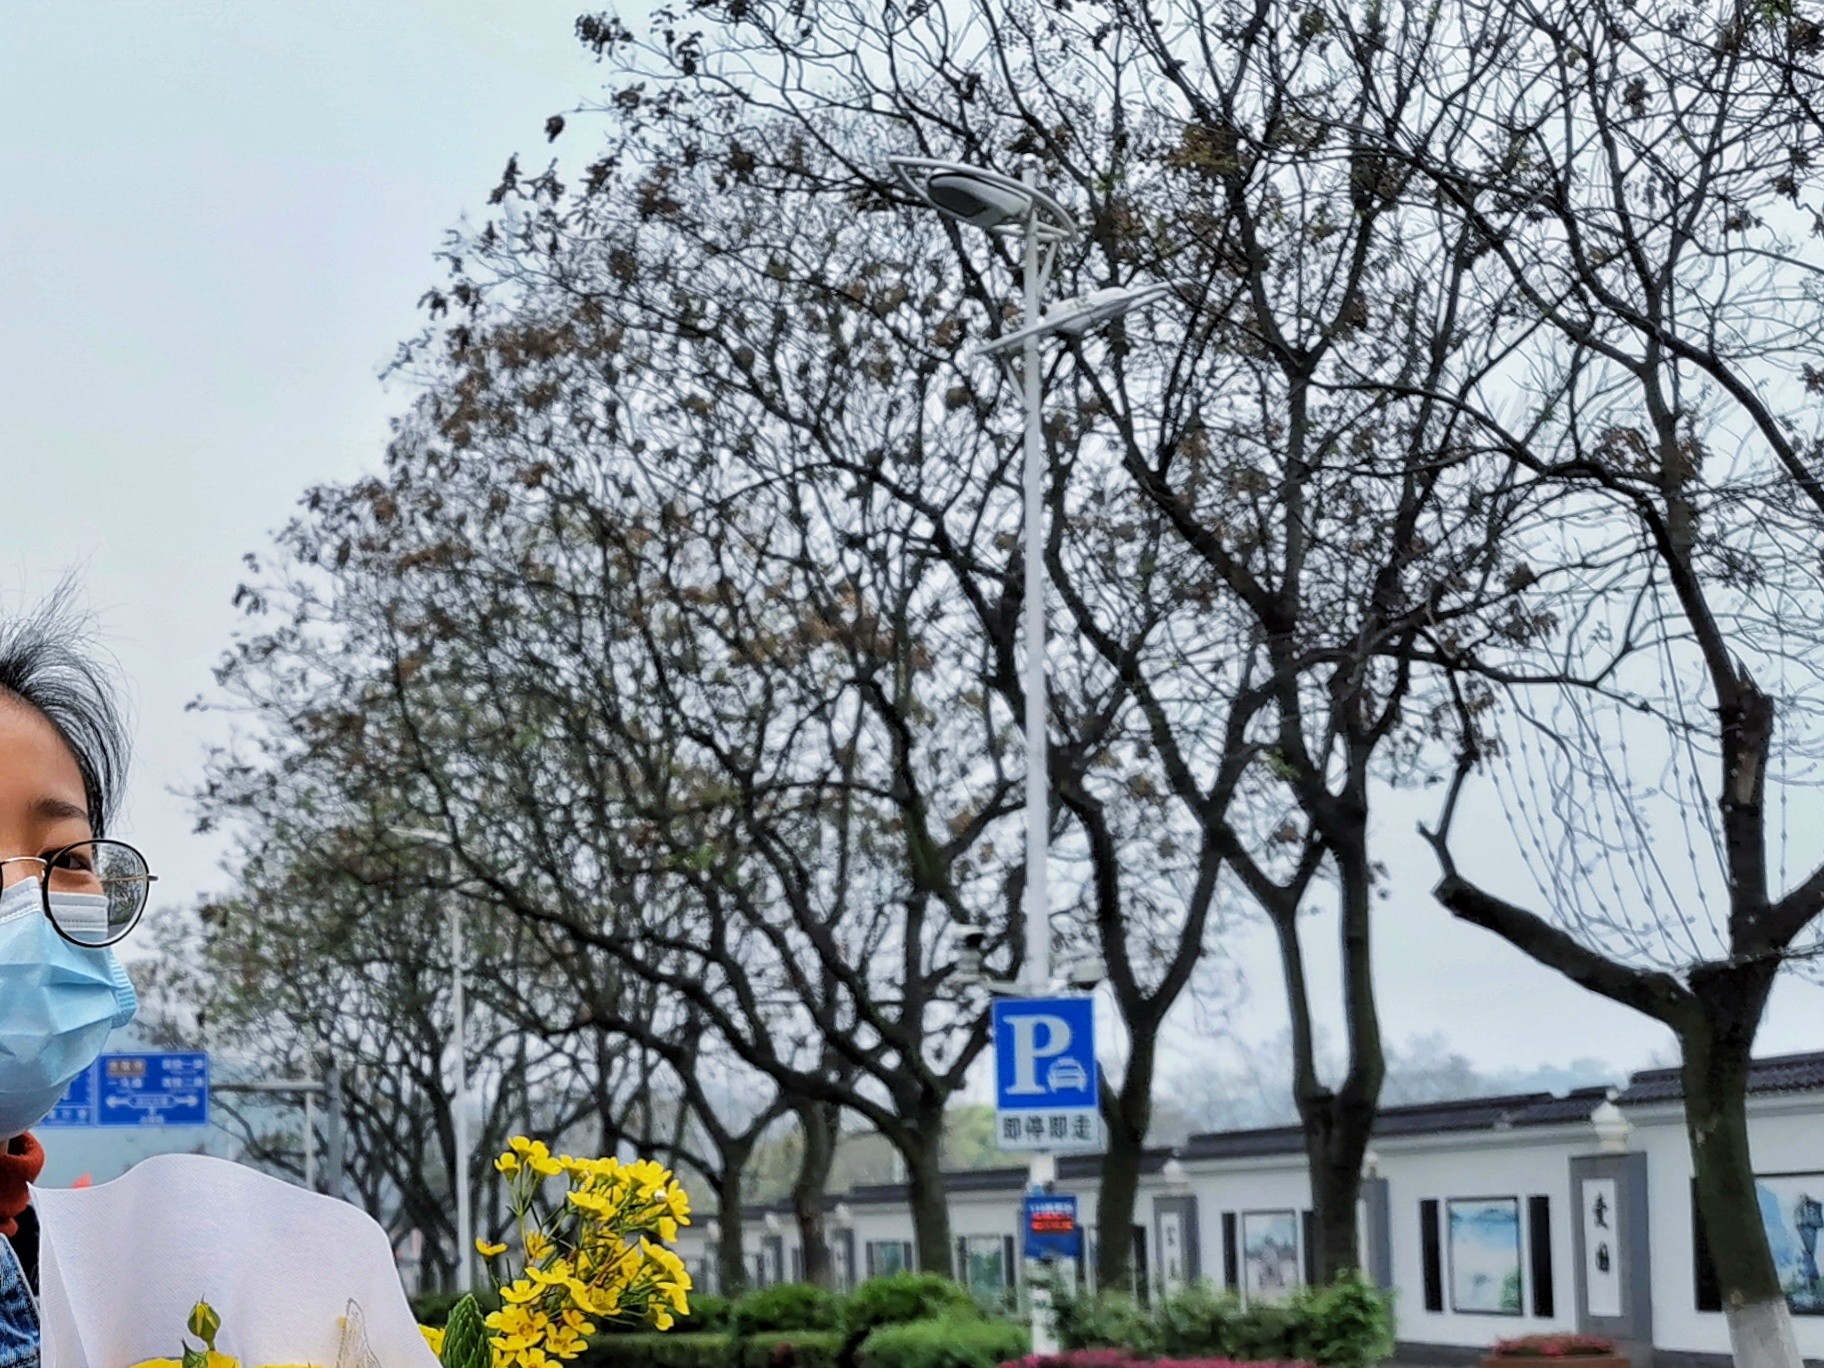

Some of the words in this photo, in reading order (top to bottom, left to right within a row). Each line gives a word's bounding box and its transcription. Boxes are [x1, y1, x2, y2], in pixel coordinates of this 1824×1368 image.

[1003, 1014, 1073, 1095] P
[1003, 1113, 1093, 1142] 即停即走
